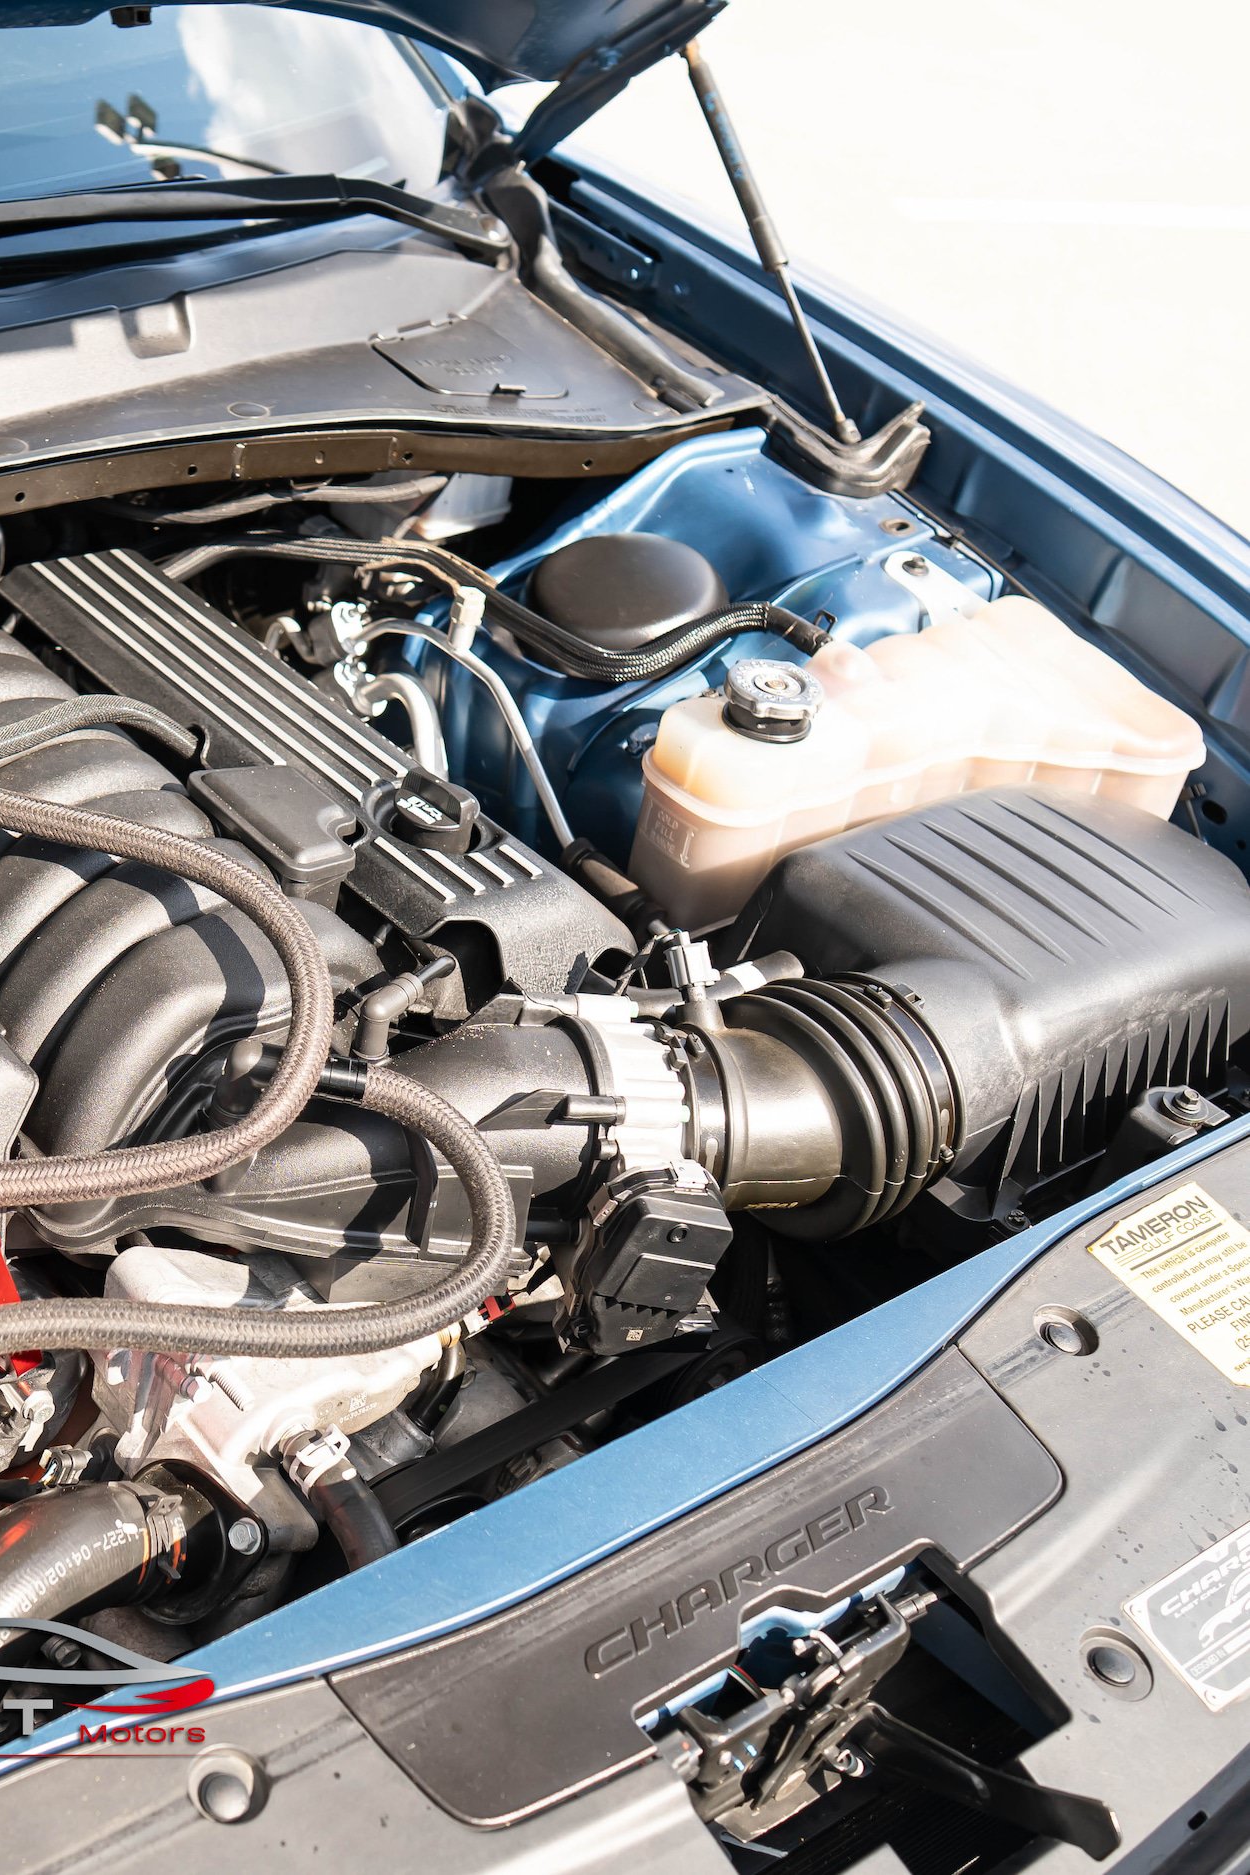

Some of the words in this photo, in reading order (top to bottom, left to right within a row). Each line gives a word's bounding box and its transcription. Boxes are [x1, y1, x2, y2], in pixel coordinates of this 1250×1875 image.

[1099, 1195, 1209, 1255] TAMERON
[1141, 1230, 1174, 1252] GULF
[1176, 1209, 1217, 1235] COAST
[1140, 1267, 1161, 1279] This
[1159, 1253, 1188, 1271] vehicle
[1184, 1249, 1196, 1258] is
[1194, 1231, 1230, 1253] computer
[1152, 1269, 1191, 1293] controlled
[1190, 1261, 1207, 1274] and
[1205, 1253, 1223, 1267] may
[1221, 1244, 1238, 1257] still
[1234, 1240, 1248, 1250] be
[1169, 1282, 1202, 1303] covered
[1199, 1271, 1223, 1288] under
[1179, 1284, 1237, 1316] Manufacturer's
[1187, 1305, 1234, 1334] PLEASE
[584, 1485, 896, 1680] CHARGER
